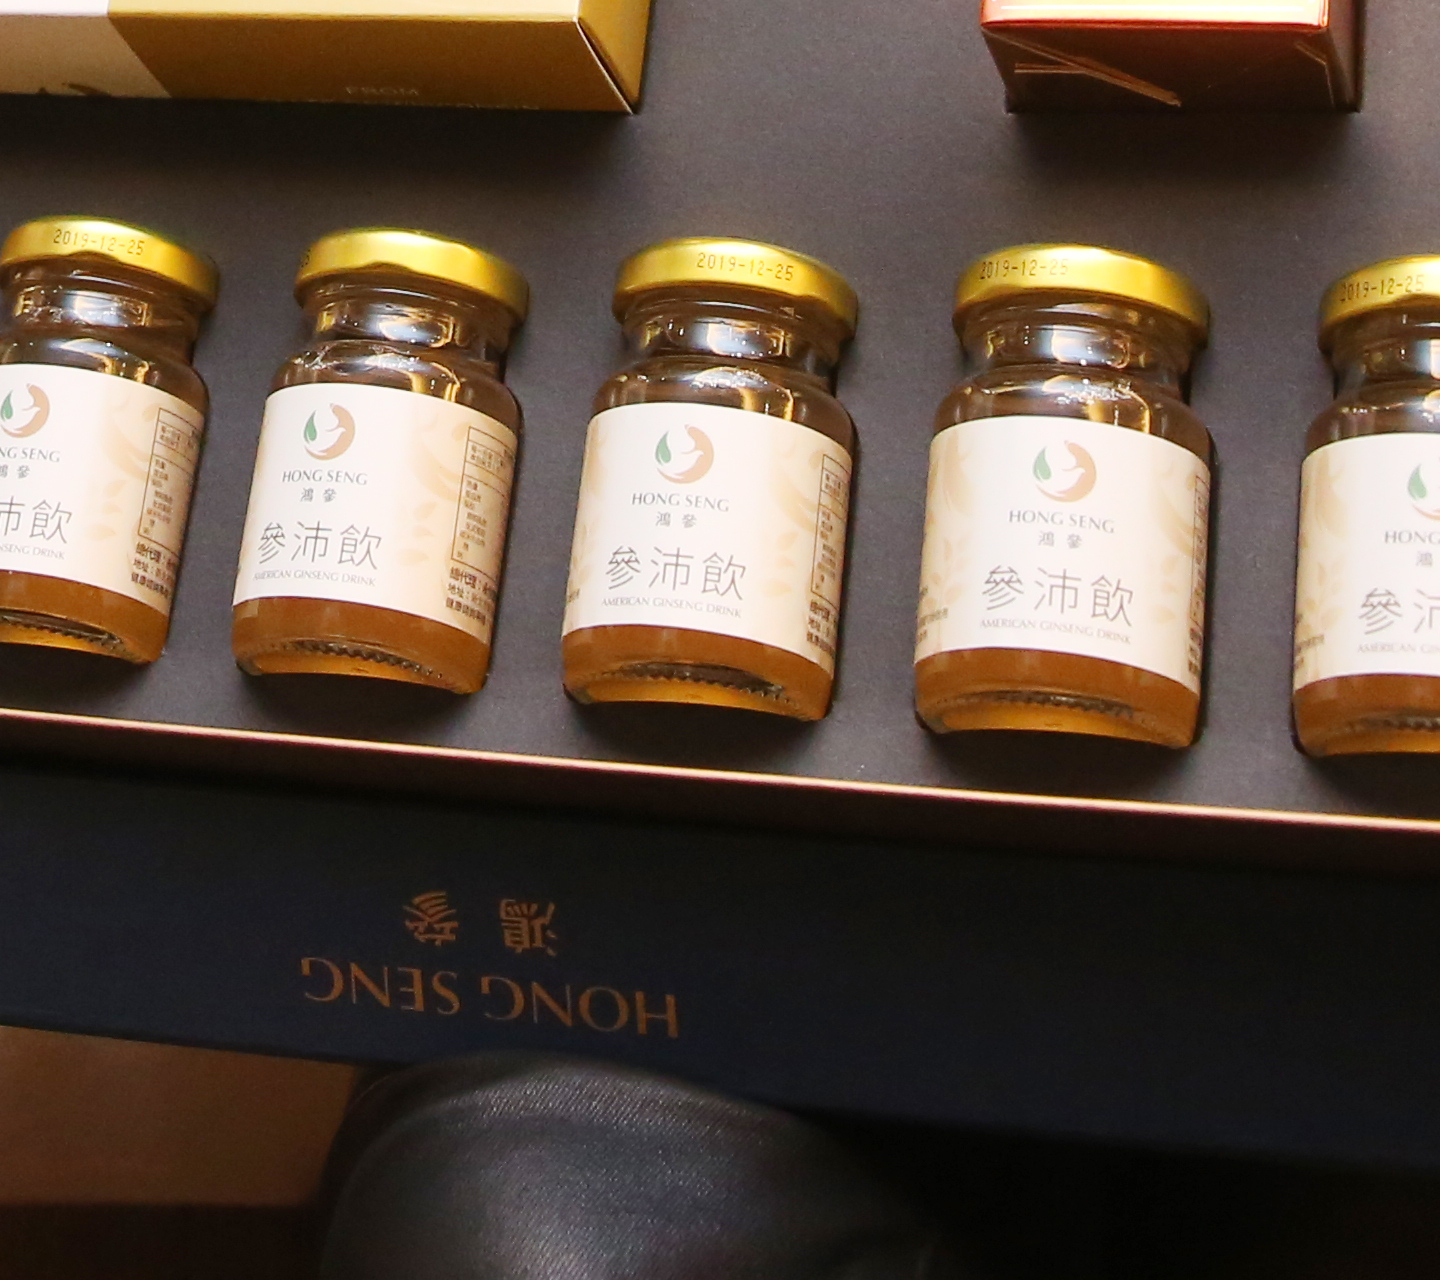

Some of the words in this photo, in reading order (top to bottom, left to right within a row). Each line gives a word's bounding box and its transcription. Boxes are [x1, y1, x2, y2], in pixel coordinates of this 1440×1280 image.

[53, 227, 145, 256] 2019-12-25
[696, 251, 795, 282] 2019-12-25
[979, 258, 1070, 280] 2019-12-25
[21, 447, 60, 463] SENG
[281, 469, 323, 483] HONG
[326, 469, 368, 486] SENG
[631, 492, 680, 506] HONG
[684, 494, 730, 513] SENG
[1008, 509, 1064, 525] HONG
[1069, 514, 1115, 534] SENG
[32, 546, 65, 560] DRINK
[257, 520, 382, 570] 參沛飲
[252, 569, 292, 582] AMERICAN
[292, 568, 340, 582] GINSENG
[341, 573, 376, 587] DRINK
[605, 545, 747, 601] 參沛飲
[601, 595, 650, 607] AMERICAN
[651, 596, 704, 612] GINSENG
[705, 603, 742, 619] DRINK
[981, 564, 1134, 630] 參沛飲
[979, 618, 1036, 629] AMERICAN
[1038, 619, 1094, 638] GINSENG
[1096, 628, 1131, 646] DRINK
[400, 889, 558, 957] 鴻參
[299, 956, 462, 1016] SENG
[480, 974, 679, 1038] HONG
